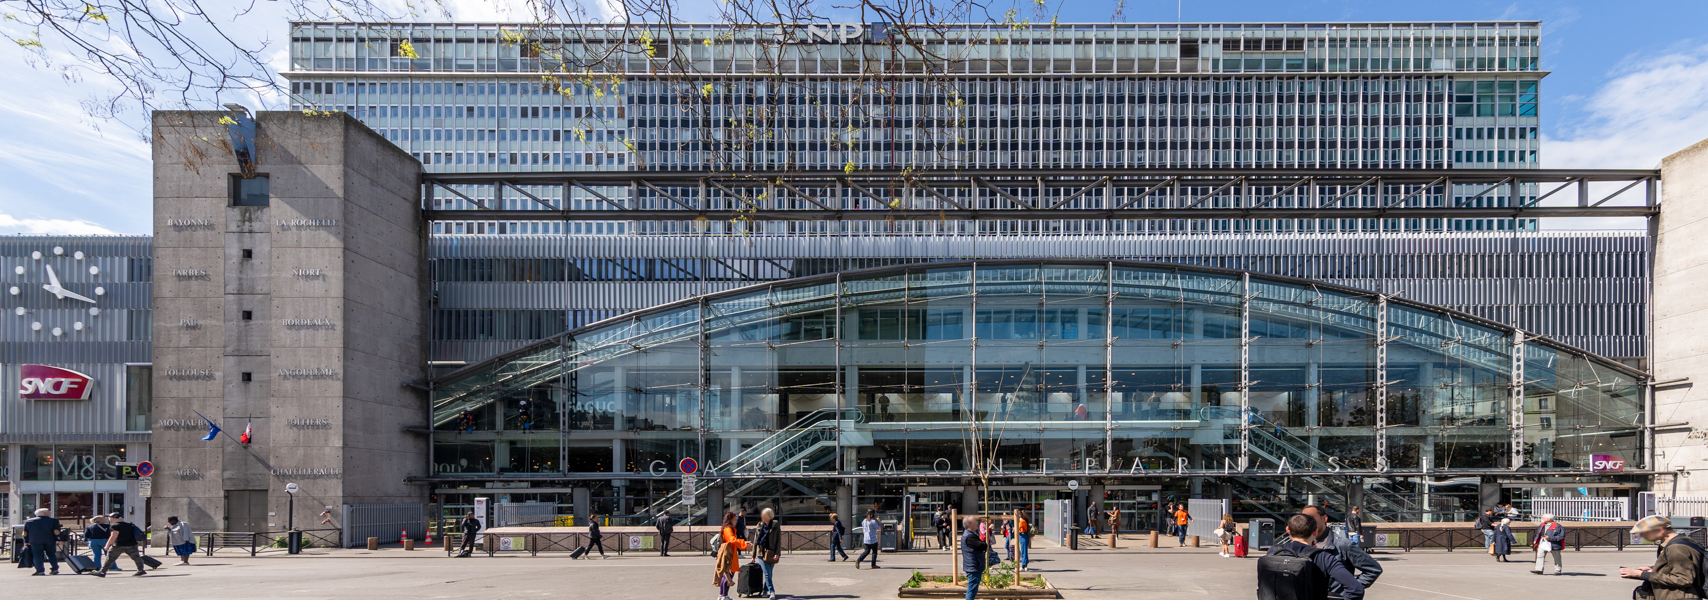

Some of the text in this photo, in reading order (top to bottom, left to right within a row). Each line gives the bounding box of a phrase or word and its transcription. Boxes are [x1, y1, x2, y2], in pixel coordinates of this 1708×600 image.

[291, 219, 339, 227] ROCHELLE
[20, 378, 82, 394] SNCF
[58, 454, 122, 480] M&S
[1593, 460, 1624, 470] SNCF
[175, 468, 198, 476] AGEN
